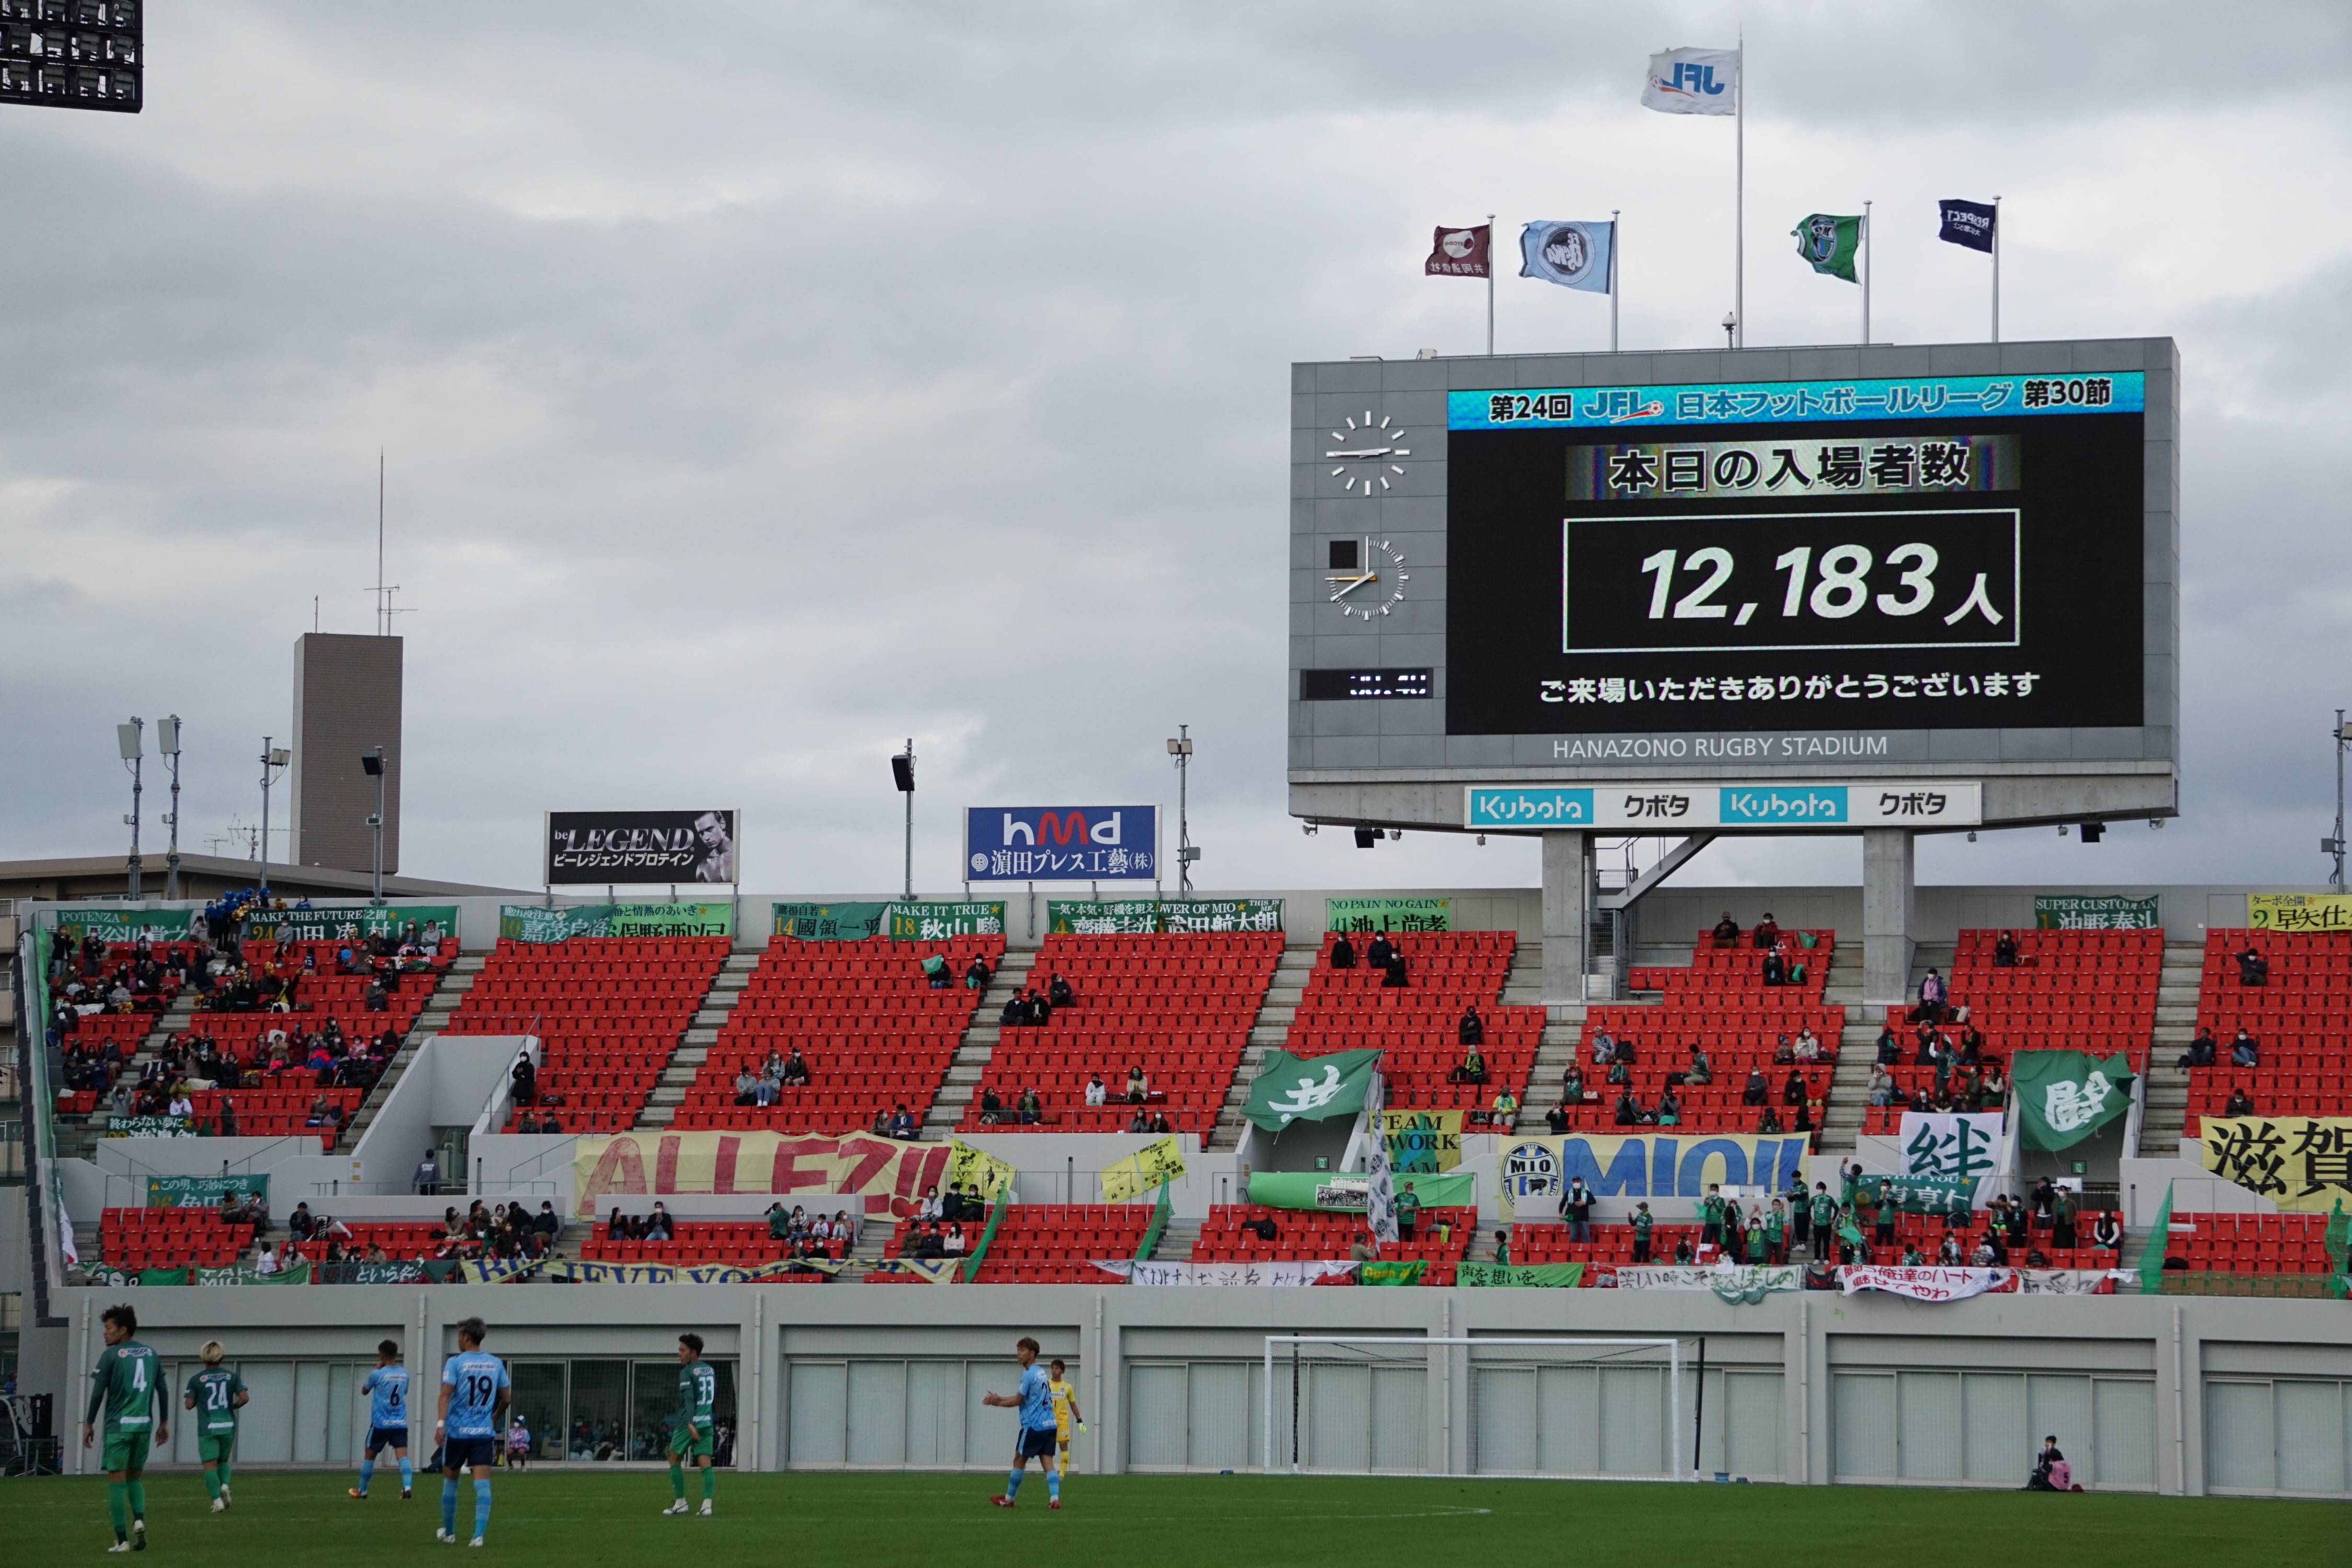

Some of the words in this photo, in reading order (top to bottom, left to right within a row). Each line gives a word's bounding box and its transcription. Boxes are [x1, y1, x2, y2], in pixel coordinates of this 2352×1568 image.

[1489, 394, 1572, 421] 第24回
[1583, 391, 1644, 418] JFL
[1677, 382, 2012, 420] 日本フットボールリーグ
[2023, 378, 2111, 407] 第30節
[1609, 442, 1969, 493] 本日の入場者数
[1540, 672, 2040, 704] ご来場いただきありがとうございます
[1554, 739, 1687, 759] HANAZONO
[1696, 737, 1773, 757] RUGBY
[1782, 736, 1887, 756] STADIUM
[1480, 795, 1582, 820] Kubota
[1624, 794, 1690, 818] クボタ
[1731, 792, 1836, 817] Kubota
[1879, 792, 1946, 816] クボタ
[554, 852, 694, 867] ビーレジェンドプロテイン
[892, 904, 929, 916] MAKE
[933, 905, 948, 916] IT
[953, 904, 989, 916] TRUE
[1193, 903, 1210, 914] OF
[1212, 903, 1236, 914] MIO
[1331, 901, 1348, 910] NO
[1350, 900, 1381, 909] PAIN
[1386, 900, 1403, 908] NO
[1405, 899, 1439, 908] GAIN
[2035, 898, 2079, 910] SUPER
[2252, 895, 2305, 906] ターボ全開
[62, 912, 120, 923] POTENZA
[287, 911, 313, 921] THE
[314, 909, 363, 921] FUTURE
[2253, 909, 2269, 929] 2
[2275, 905, 2352, 930] 早矢仕
[775, 917, 794, 936] 14
[894, 916, 915, 936] 18
[109, 1115, 183, 1129] 終わらない夢に
[1140, 1143, 1158, 1154] DREAM
[1386, 1134, 1459, 1150] WORK
[1907, 1117, 1994, 1176] 絆
[1511, 1159, 1551, 1173] MIO
[2208, 1121, 2352, 1197] 滋賀
[1928, 1175, 1959, 1184] YOU
[133, 1358, 147, 1391] 4
[205, 1381, 228, 1410] 24
[390, 1384, 400, 1406] 6
[468, 1375, 492, 1406] 19
[697, 1376, 714, 1405] 33
